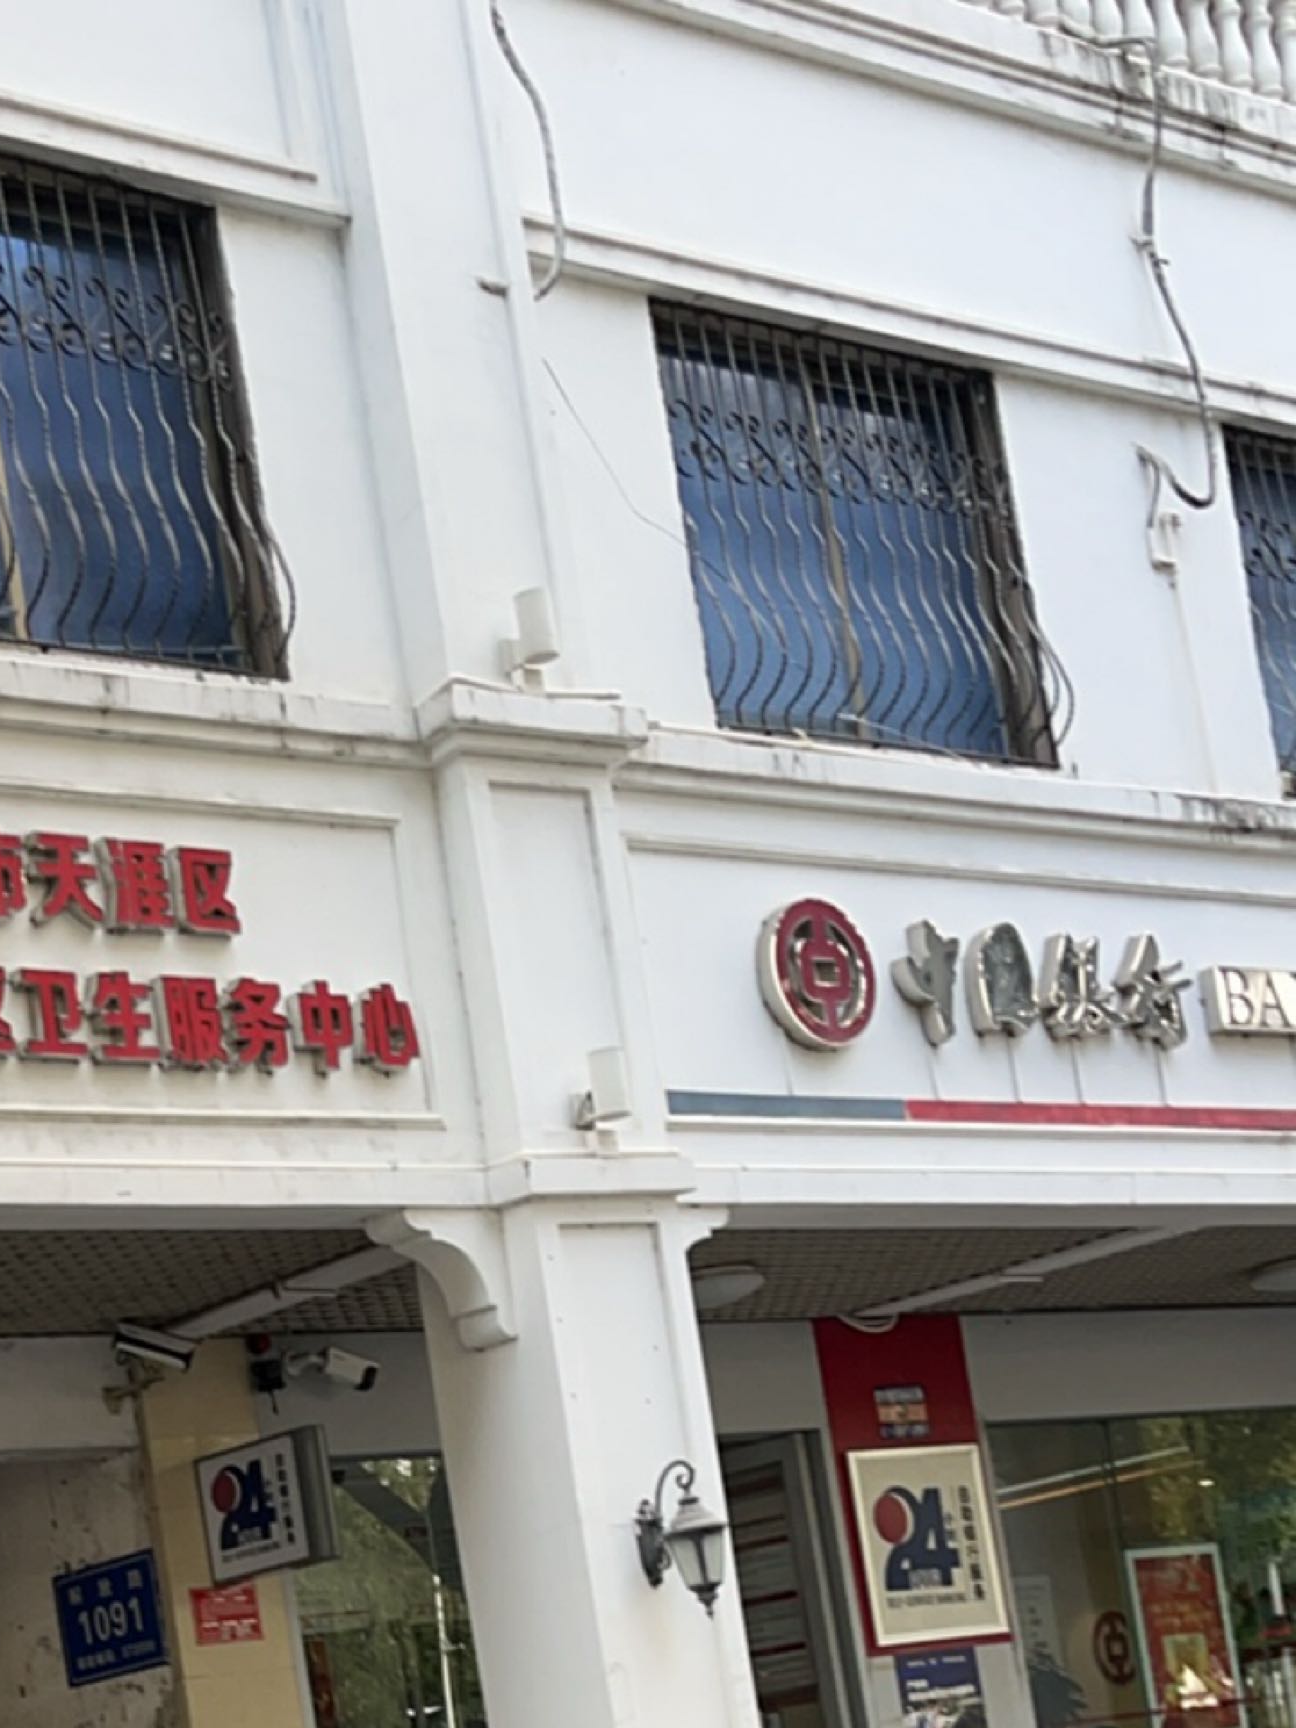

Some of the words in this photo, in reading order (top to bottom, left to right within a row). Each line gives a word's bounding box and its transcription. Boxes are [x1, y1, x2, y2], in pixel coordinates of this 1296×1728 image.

[891, 919, 1192, 1050] 中国银行
[77, 1596, 144, 1646] 1091
